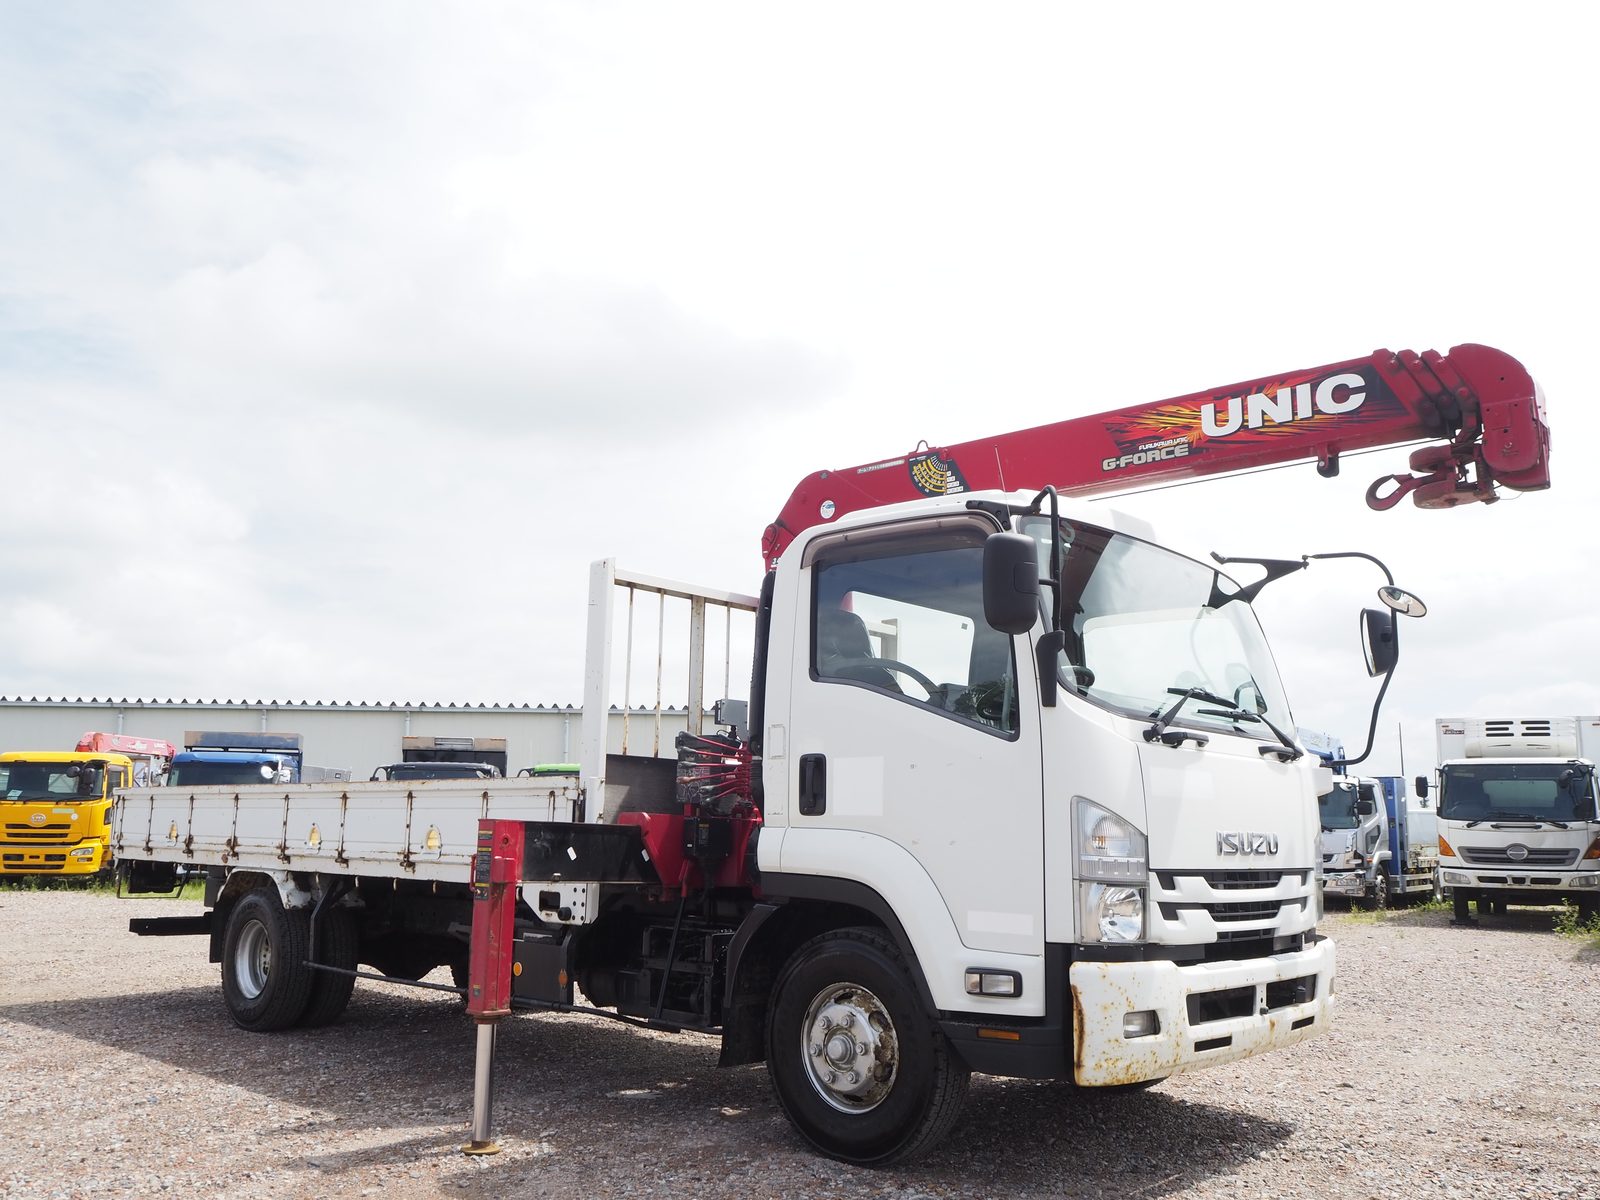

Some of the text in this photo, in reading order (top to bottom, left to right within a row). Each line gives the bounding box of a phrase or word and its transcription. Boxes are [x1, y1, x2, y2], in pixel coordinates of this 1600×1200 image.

[1201, 373, 1367, 437] UNIC
[1138, 439, 1173, 451] FURUKAWA
[1216, 831, 1279, 856] ISUZU
